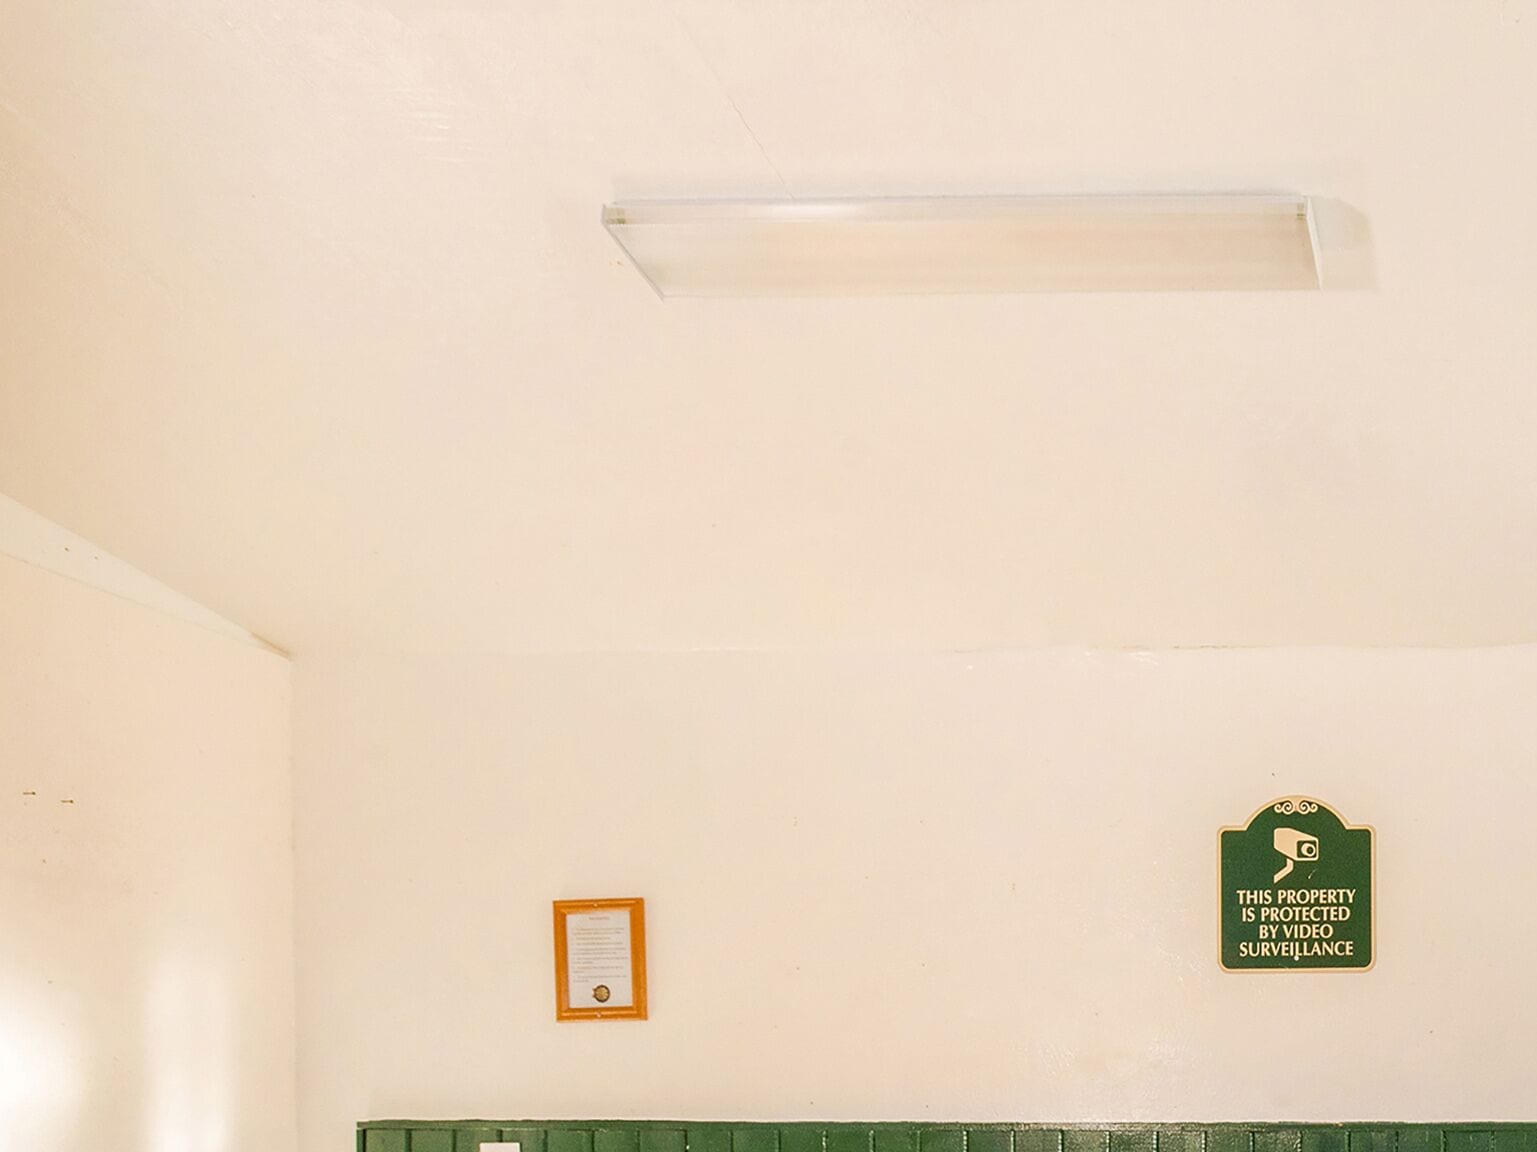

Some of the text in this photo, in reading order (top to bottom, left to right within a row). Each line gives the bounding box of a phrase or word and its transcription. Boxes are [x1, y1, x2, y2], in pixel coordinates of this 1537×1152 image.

[1236, 889, 1356, 905] THIS PROPERTY
[1242, 906, 1350, 922] IS PROTECTED
[1259, 923, 1334, 939] BY VIDEO
[1239, 941, 1354, 957] SURVEILLANCE
